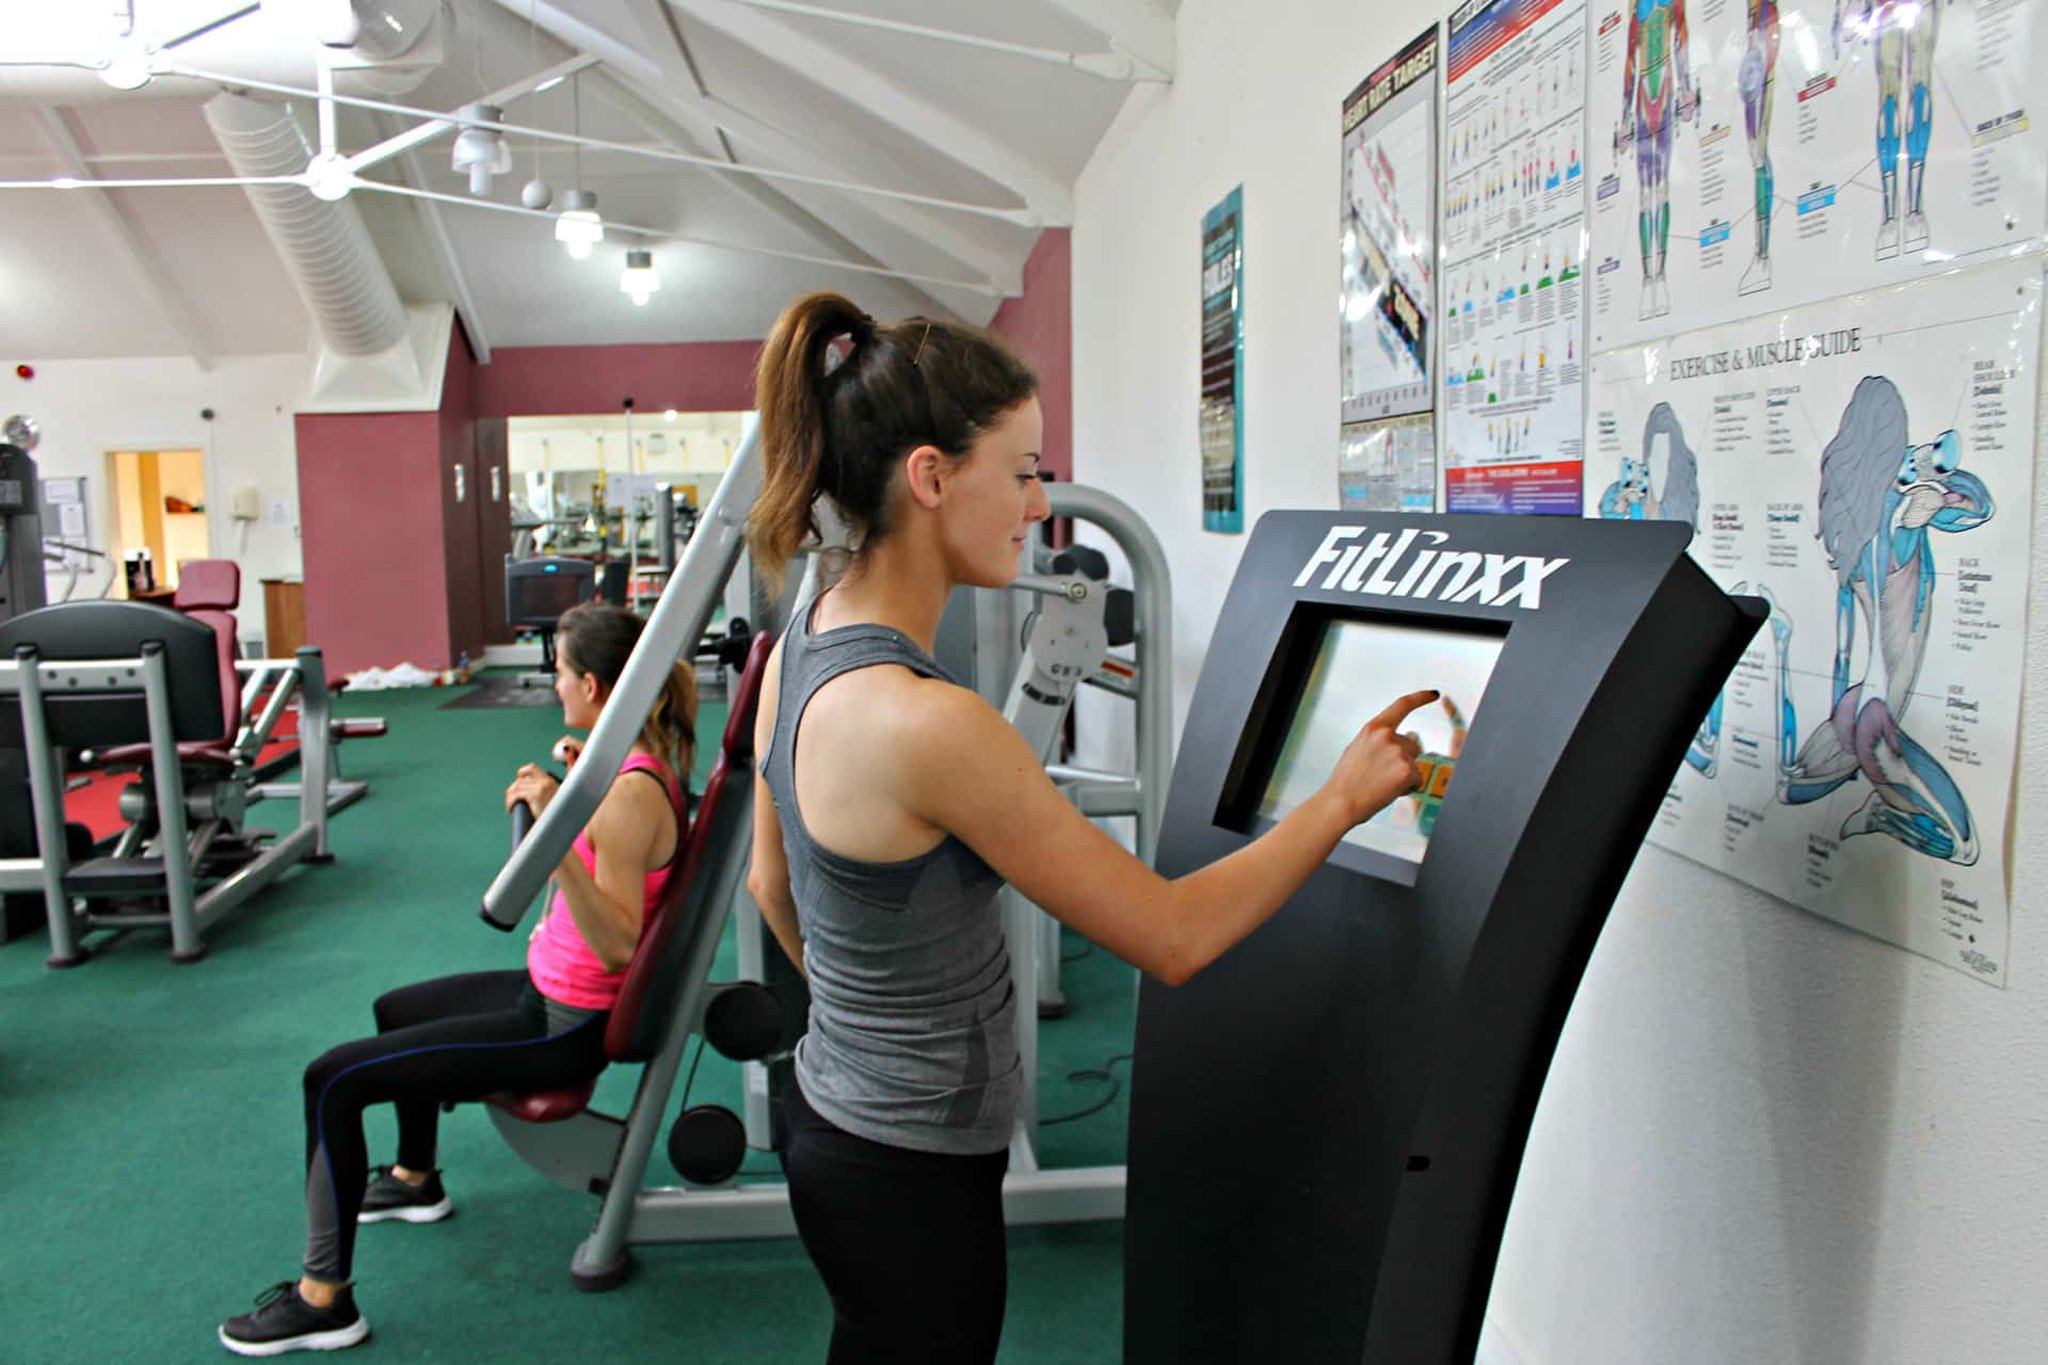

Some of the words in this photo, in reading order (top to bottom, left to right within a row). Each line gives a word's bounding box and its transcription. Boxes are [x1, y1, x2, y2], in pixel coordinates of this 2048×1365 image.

[1670, 351, 1730, 380] EXERCISE
[1731, 350, 1743, 371] &
[1746, 337, 1804, 369] MUSCLE
[1292, 525, 1571, 610] FitLinxx
